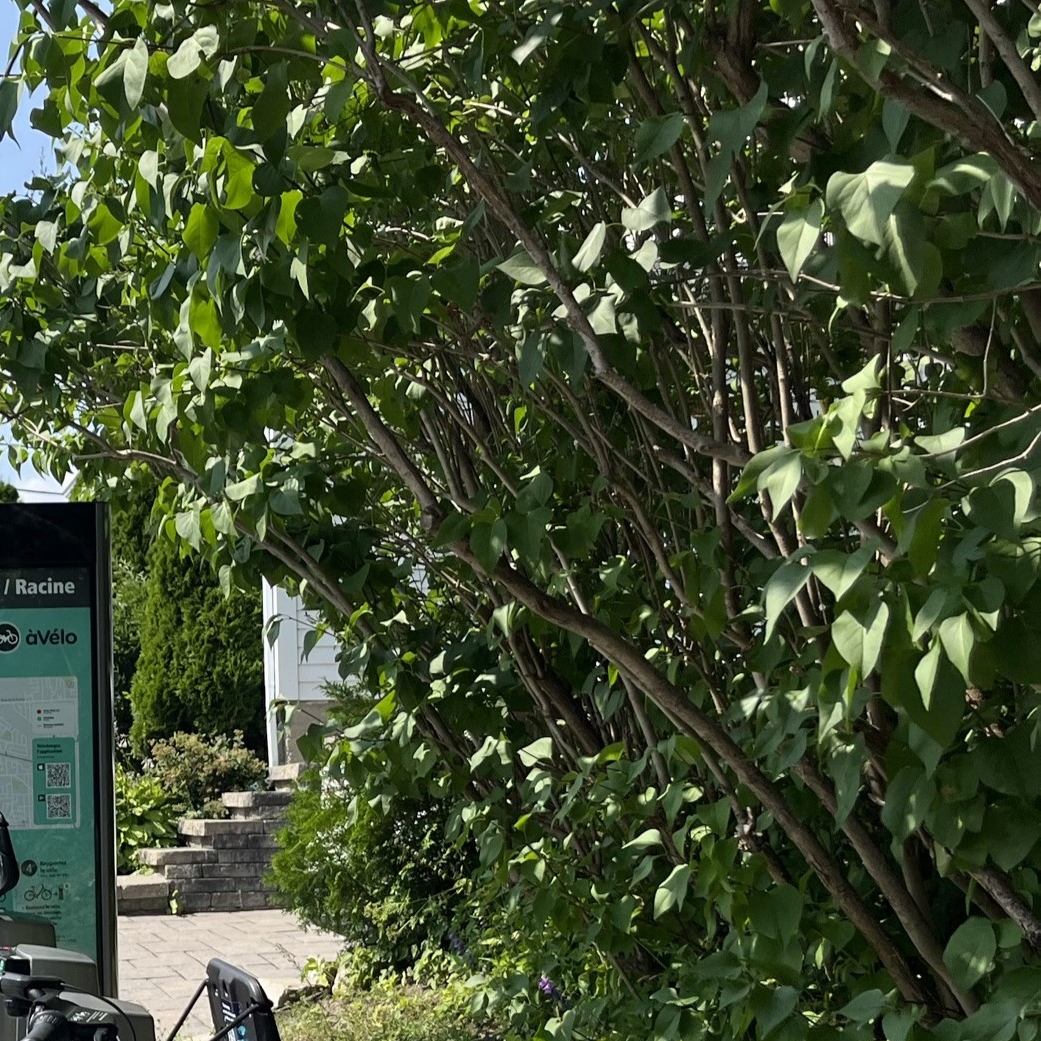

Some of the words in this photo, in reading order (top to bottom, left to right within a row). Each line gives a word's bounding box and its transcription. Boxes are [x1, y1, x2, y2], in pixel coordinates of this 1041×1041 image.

[4, 579, 10, 595] /
[15, 577, 76, 595] Racine
[25, 628, 78, 646] àVélo
